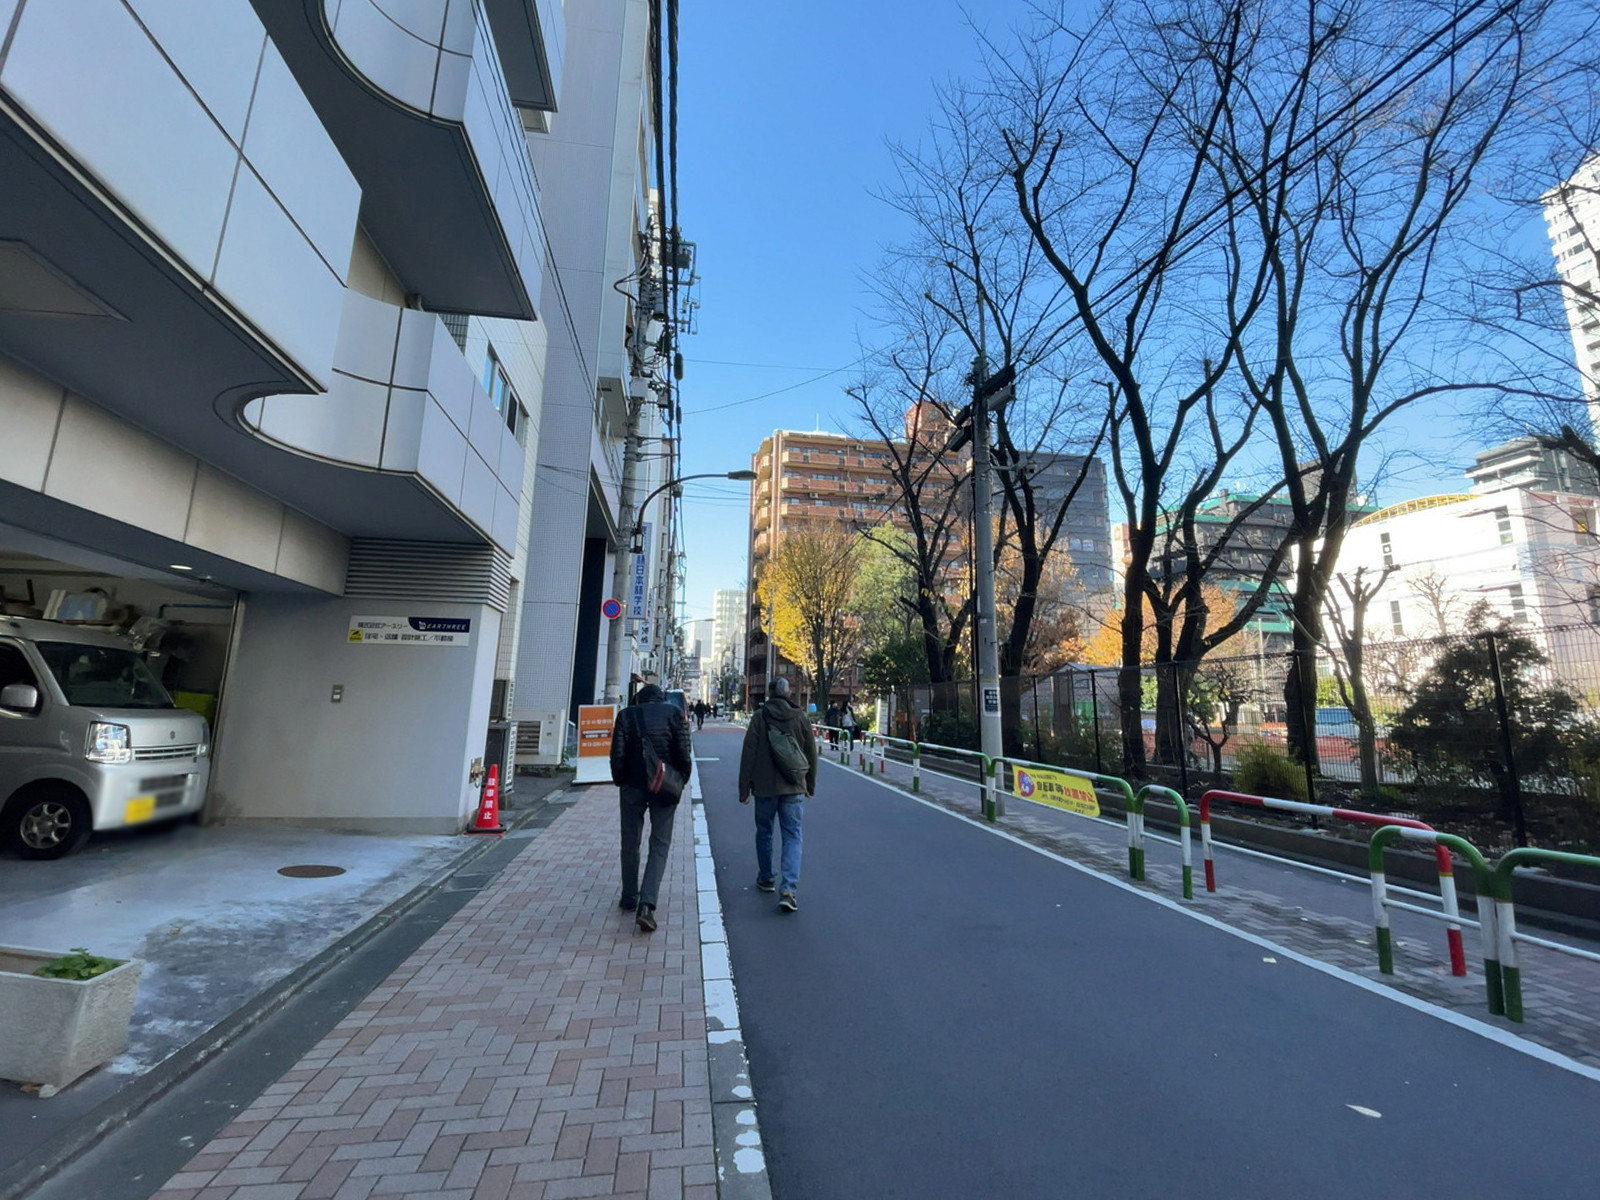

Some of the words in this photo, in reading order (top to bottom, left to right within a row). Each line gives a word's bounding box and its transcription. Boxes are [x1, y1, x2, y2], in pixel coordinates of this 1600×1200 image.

[427, 623, 467, 631] EARTHREE
[483, 777, 496, 820] 駐車禁止
